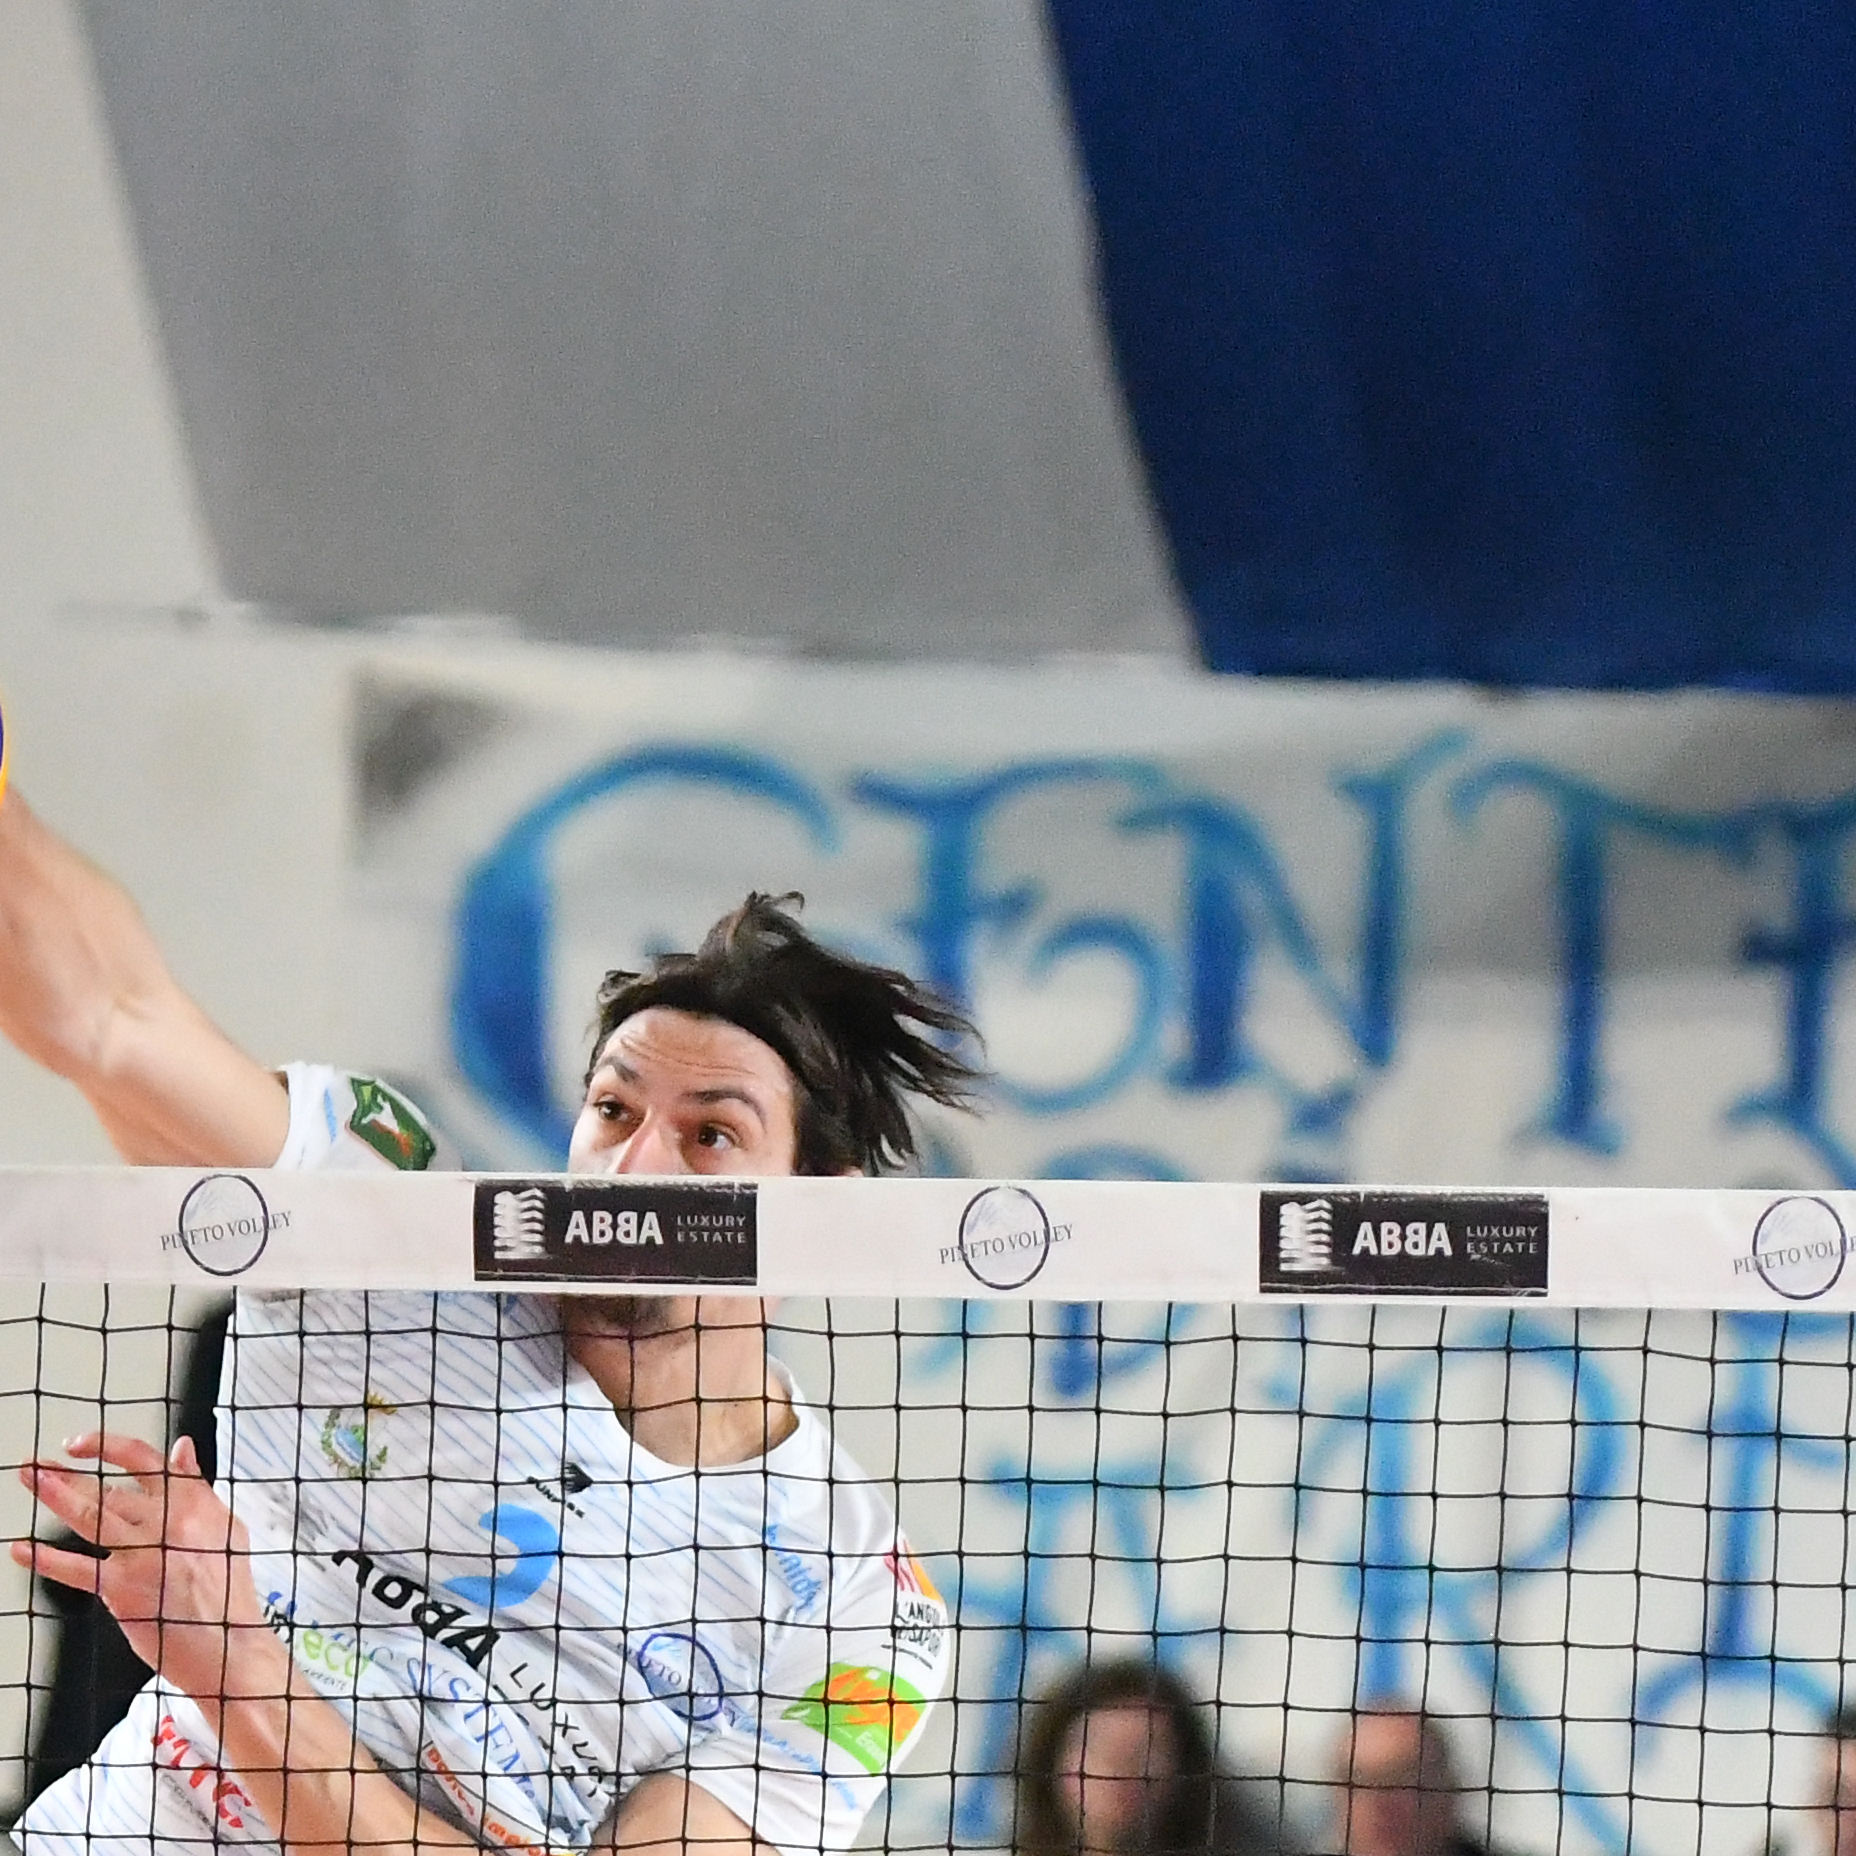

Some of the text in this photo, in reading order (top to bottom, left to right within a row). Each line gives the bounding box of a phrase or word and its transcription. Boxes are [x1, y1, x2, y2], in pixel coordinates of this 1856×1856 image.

[565, 1211, 663, 1246] ABBA
[677, 1214, 746, 1228] LUXURY
[677, 1230, 746, 1245] ESTATE
[1352, 1219, 1452, 1257] ABBA
[1466, 1224, 1540, 1238] LUXURY
[1466, 1239, 1540, 1254] ESTATE
